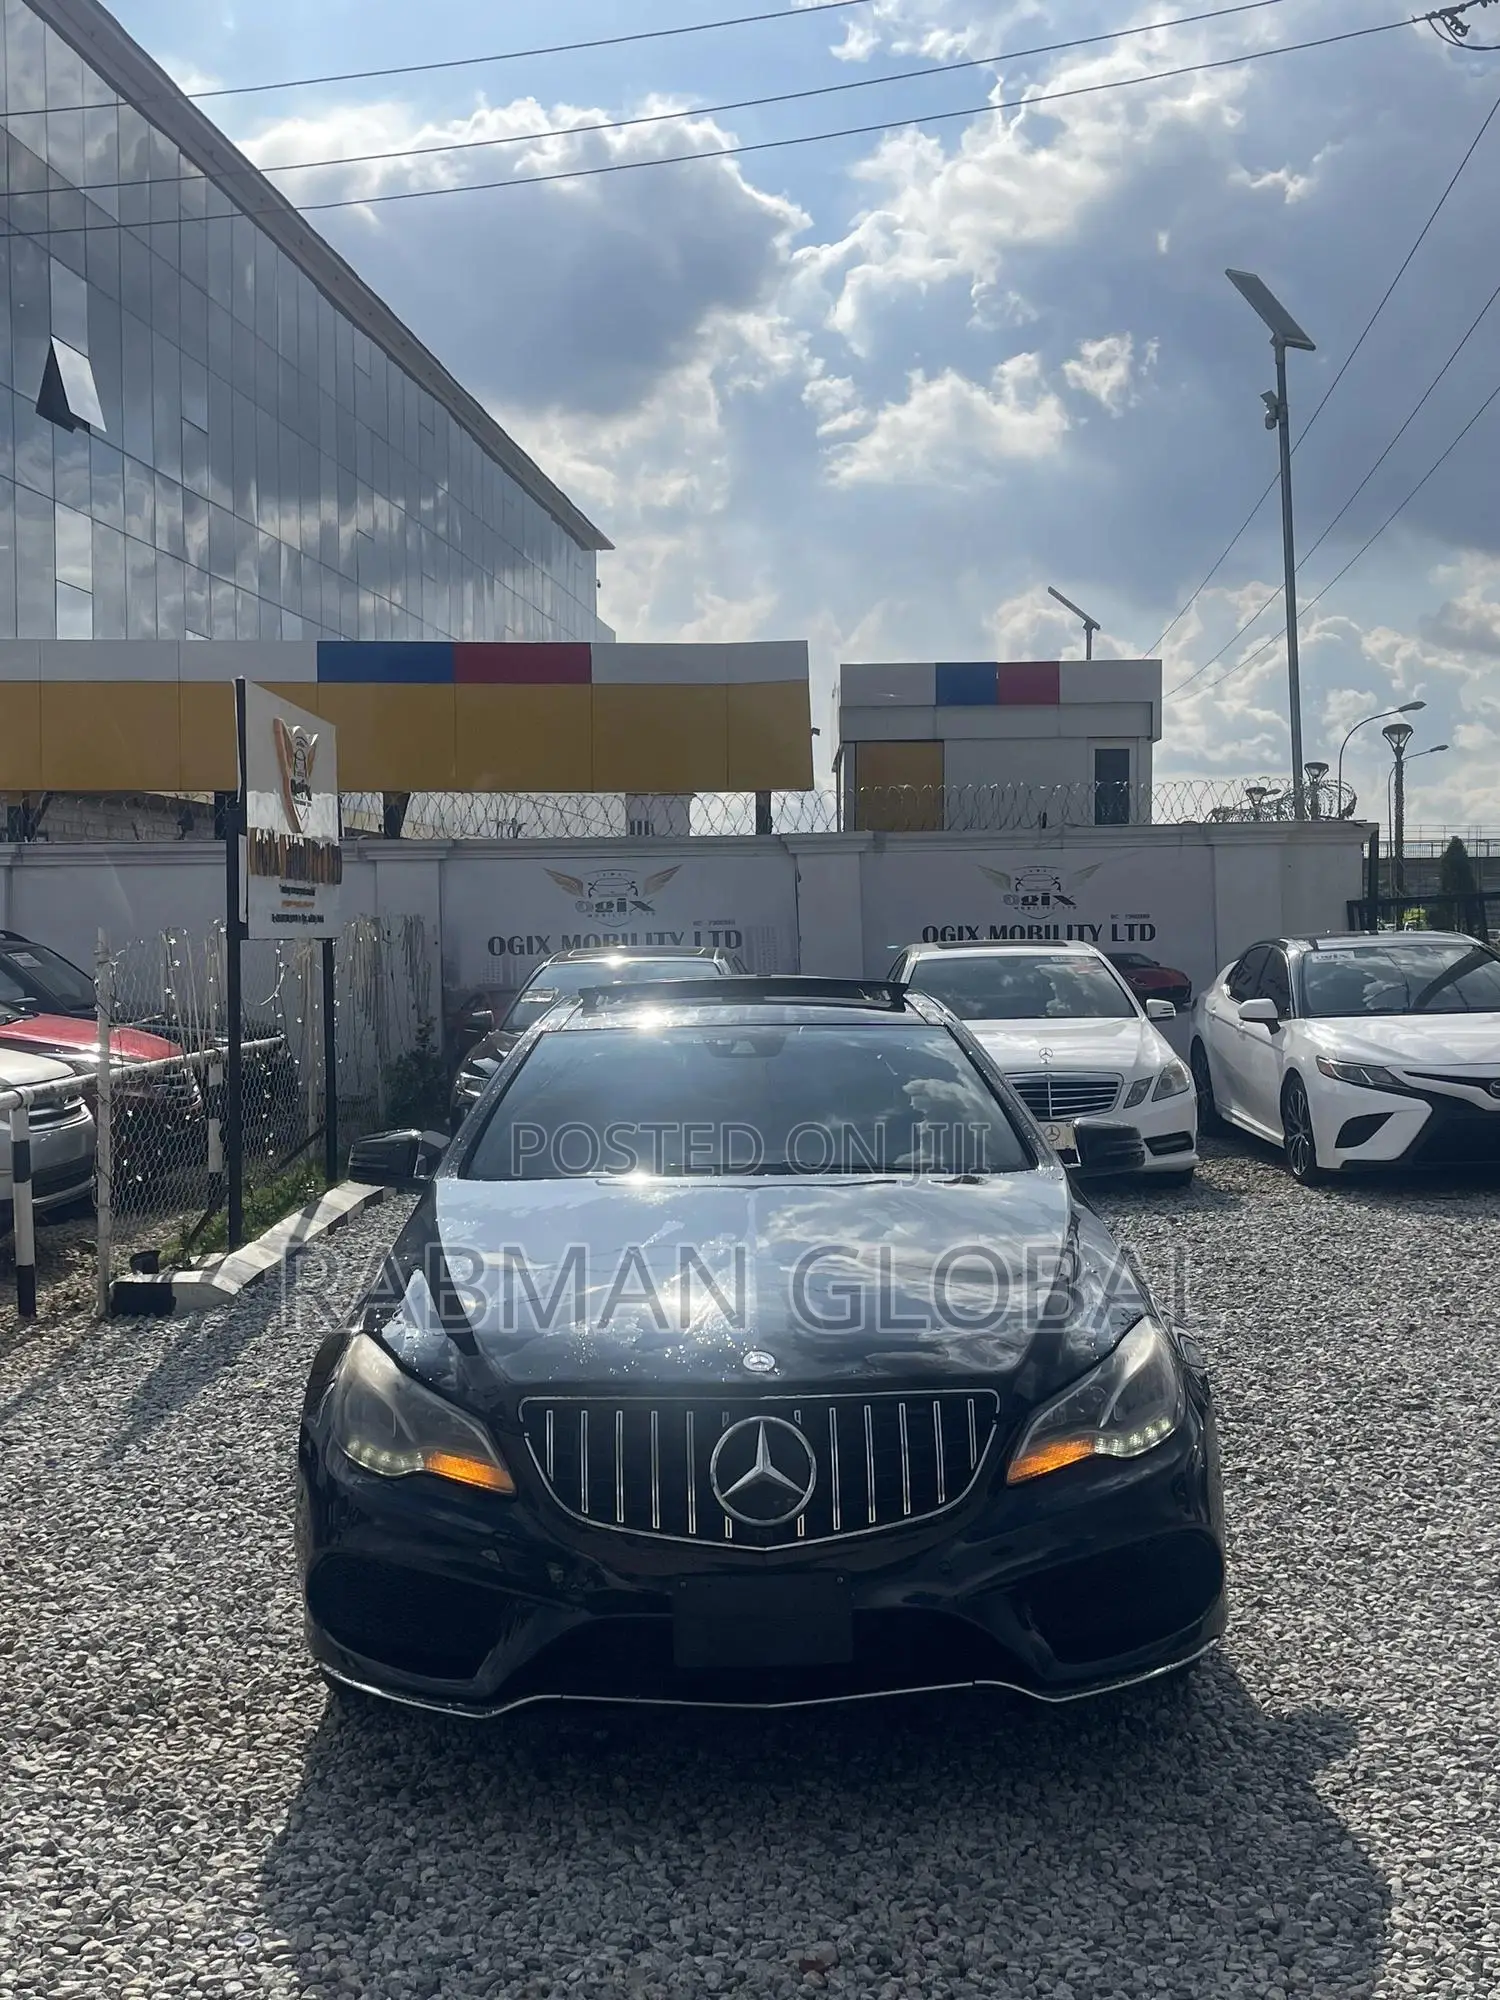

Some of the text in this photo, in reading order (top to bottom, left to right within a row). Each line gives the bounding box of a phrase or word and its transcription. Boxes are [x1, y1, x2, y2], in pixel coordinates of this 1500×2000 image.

[921, 923, 1157, 944] OGIX MOBILITY LTD
[487, 934, 552, 957] OGIX
